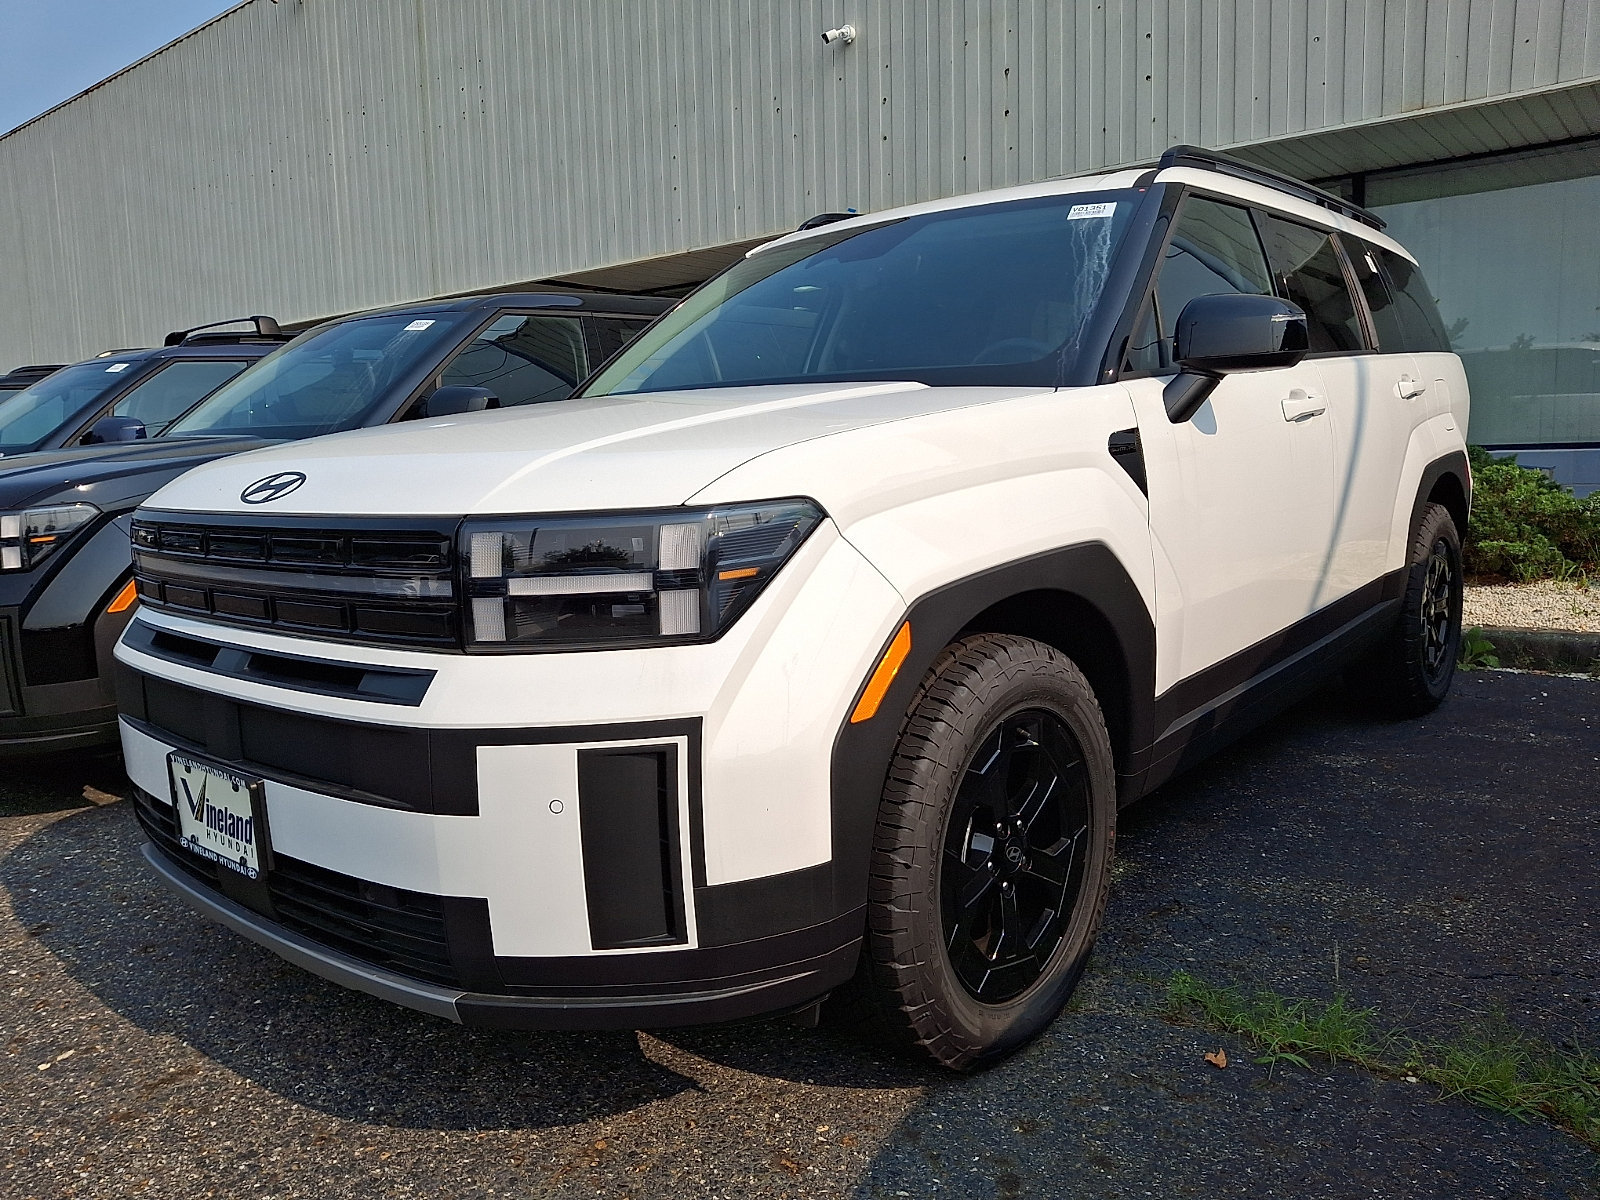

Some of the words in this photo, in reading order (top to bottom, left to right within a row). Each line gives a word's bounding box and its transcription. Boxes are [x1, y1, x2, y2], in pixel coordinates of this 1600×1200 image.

[180, 772, 253, 846] Vineland
[189, 842, 218, 862] VINELAND
[219, 857, 247, 877] HYUNDAI
[206, 828, 254, 859] HYUNDAI
